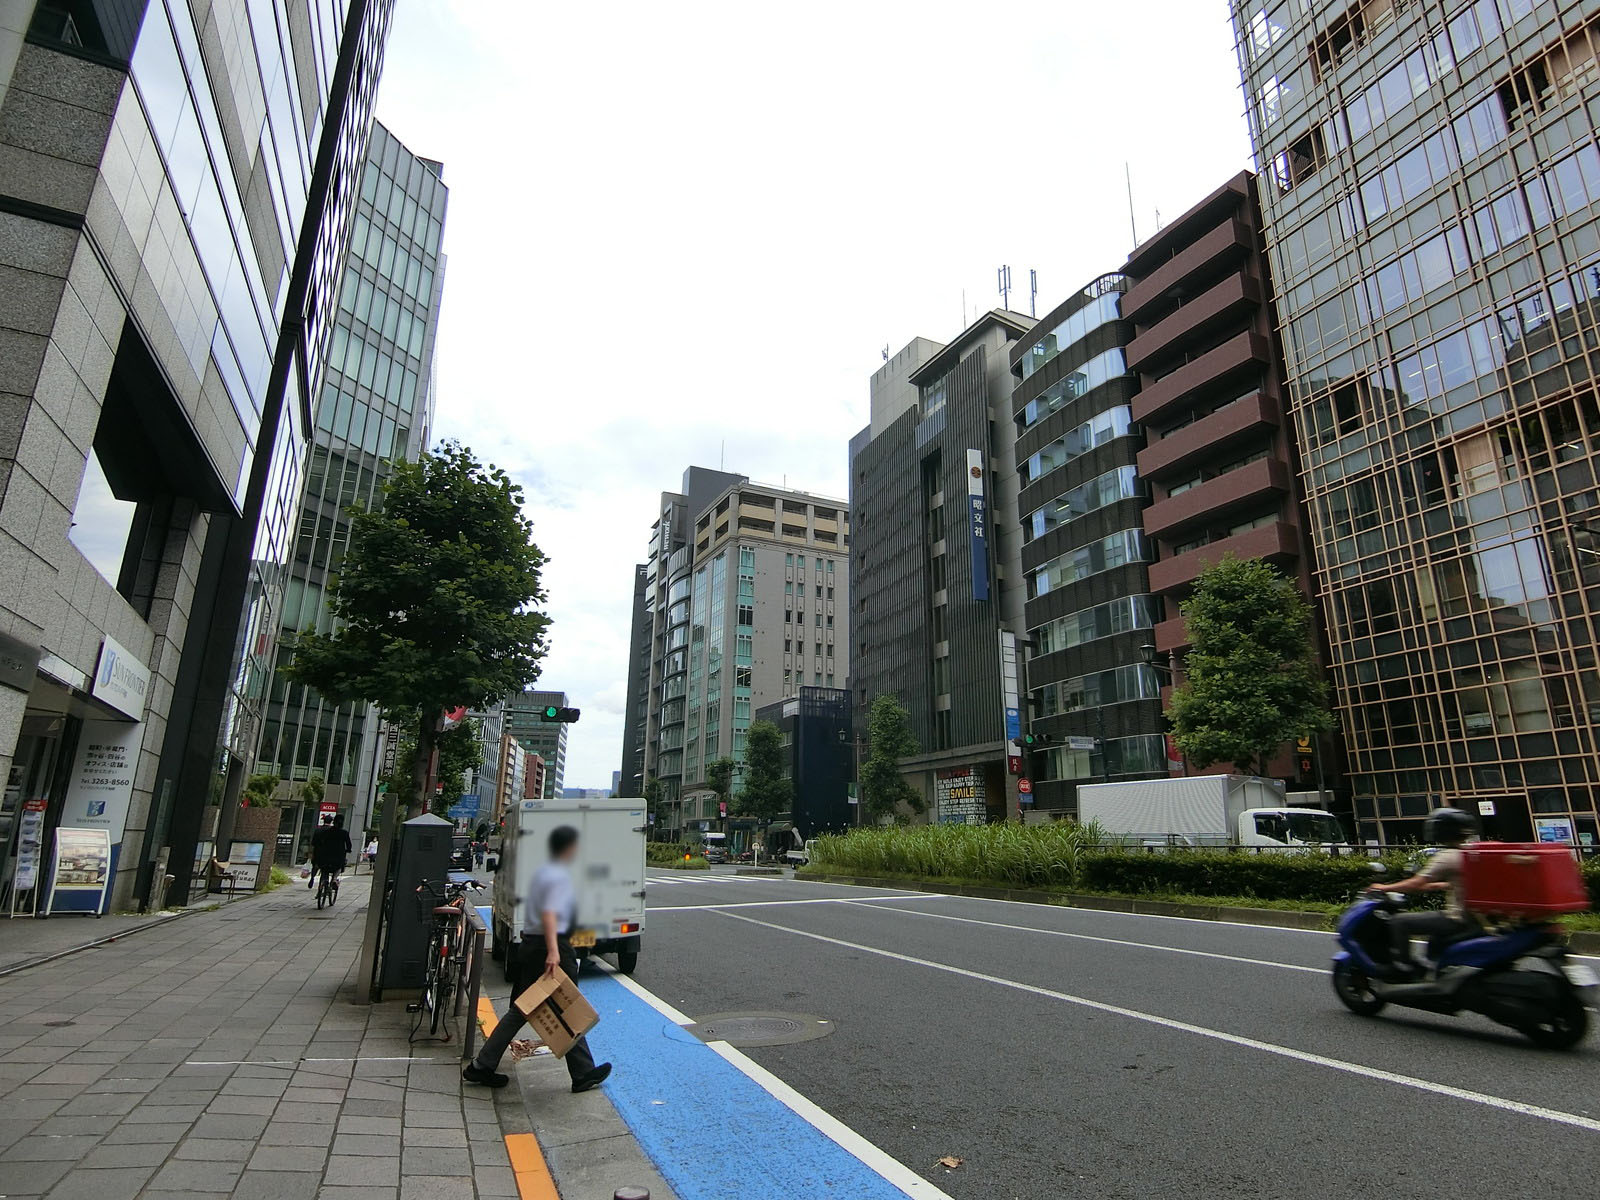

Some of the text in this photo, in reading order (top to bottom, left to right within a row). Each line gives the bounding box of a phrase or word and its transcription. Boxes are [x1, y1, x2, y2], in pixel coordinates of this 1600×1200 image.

[972, 499, 984, 537] 昭文社
[91, 778, 130, 786] 3263-8560
[950, 787, 974, 799] SMILE
